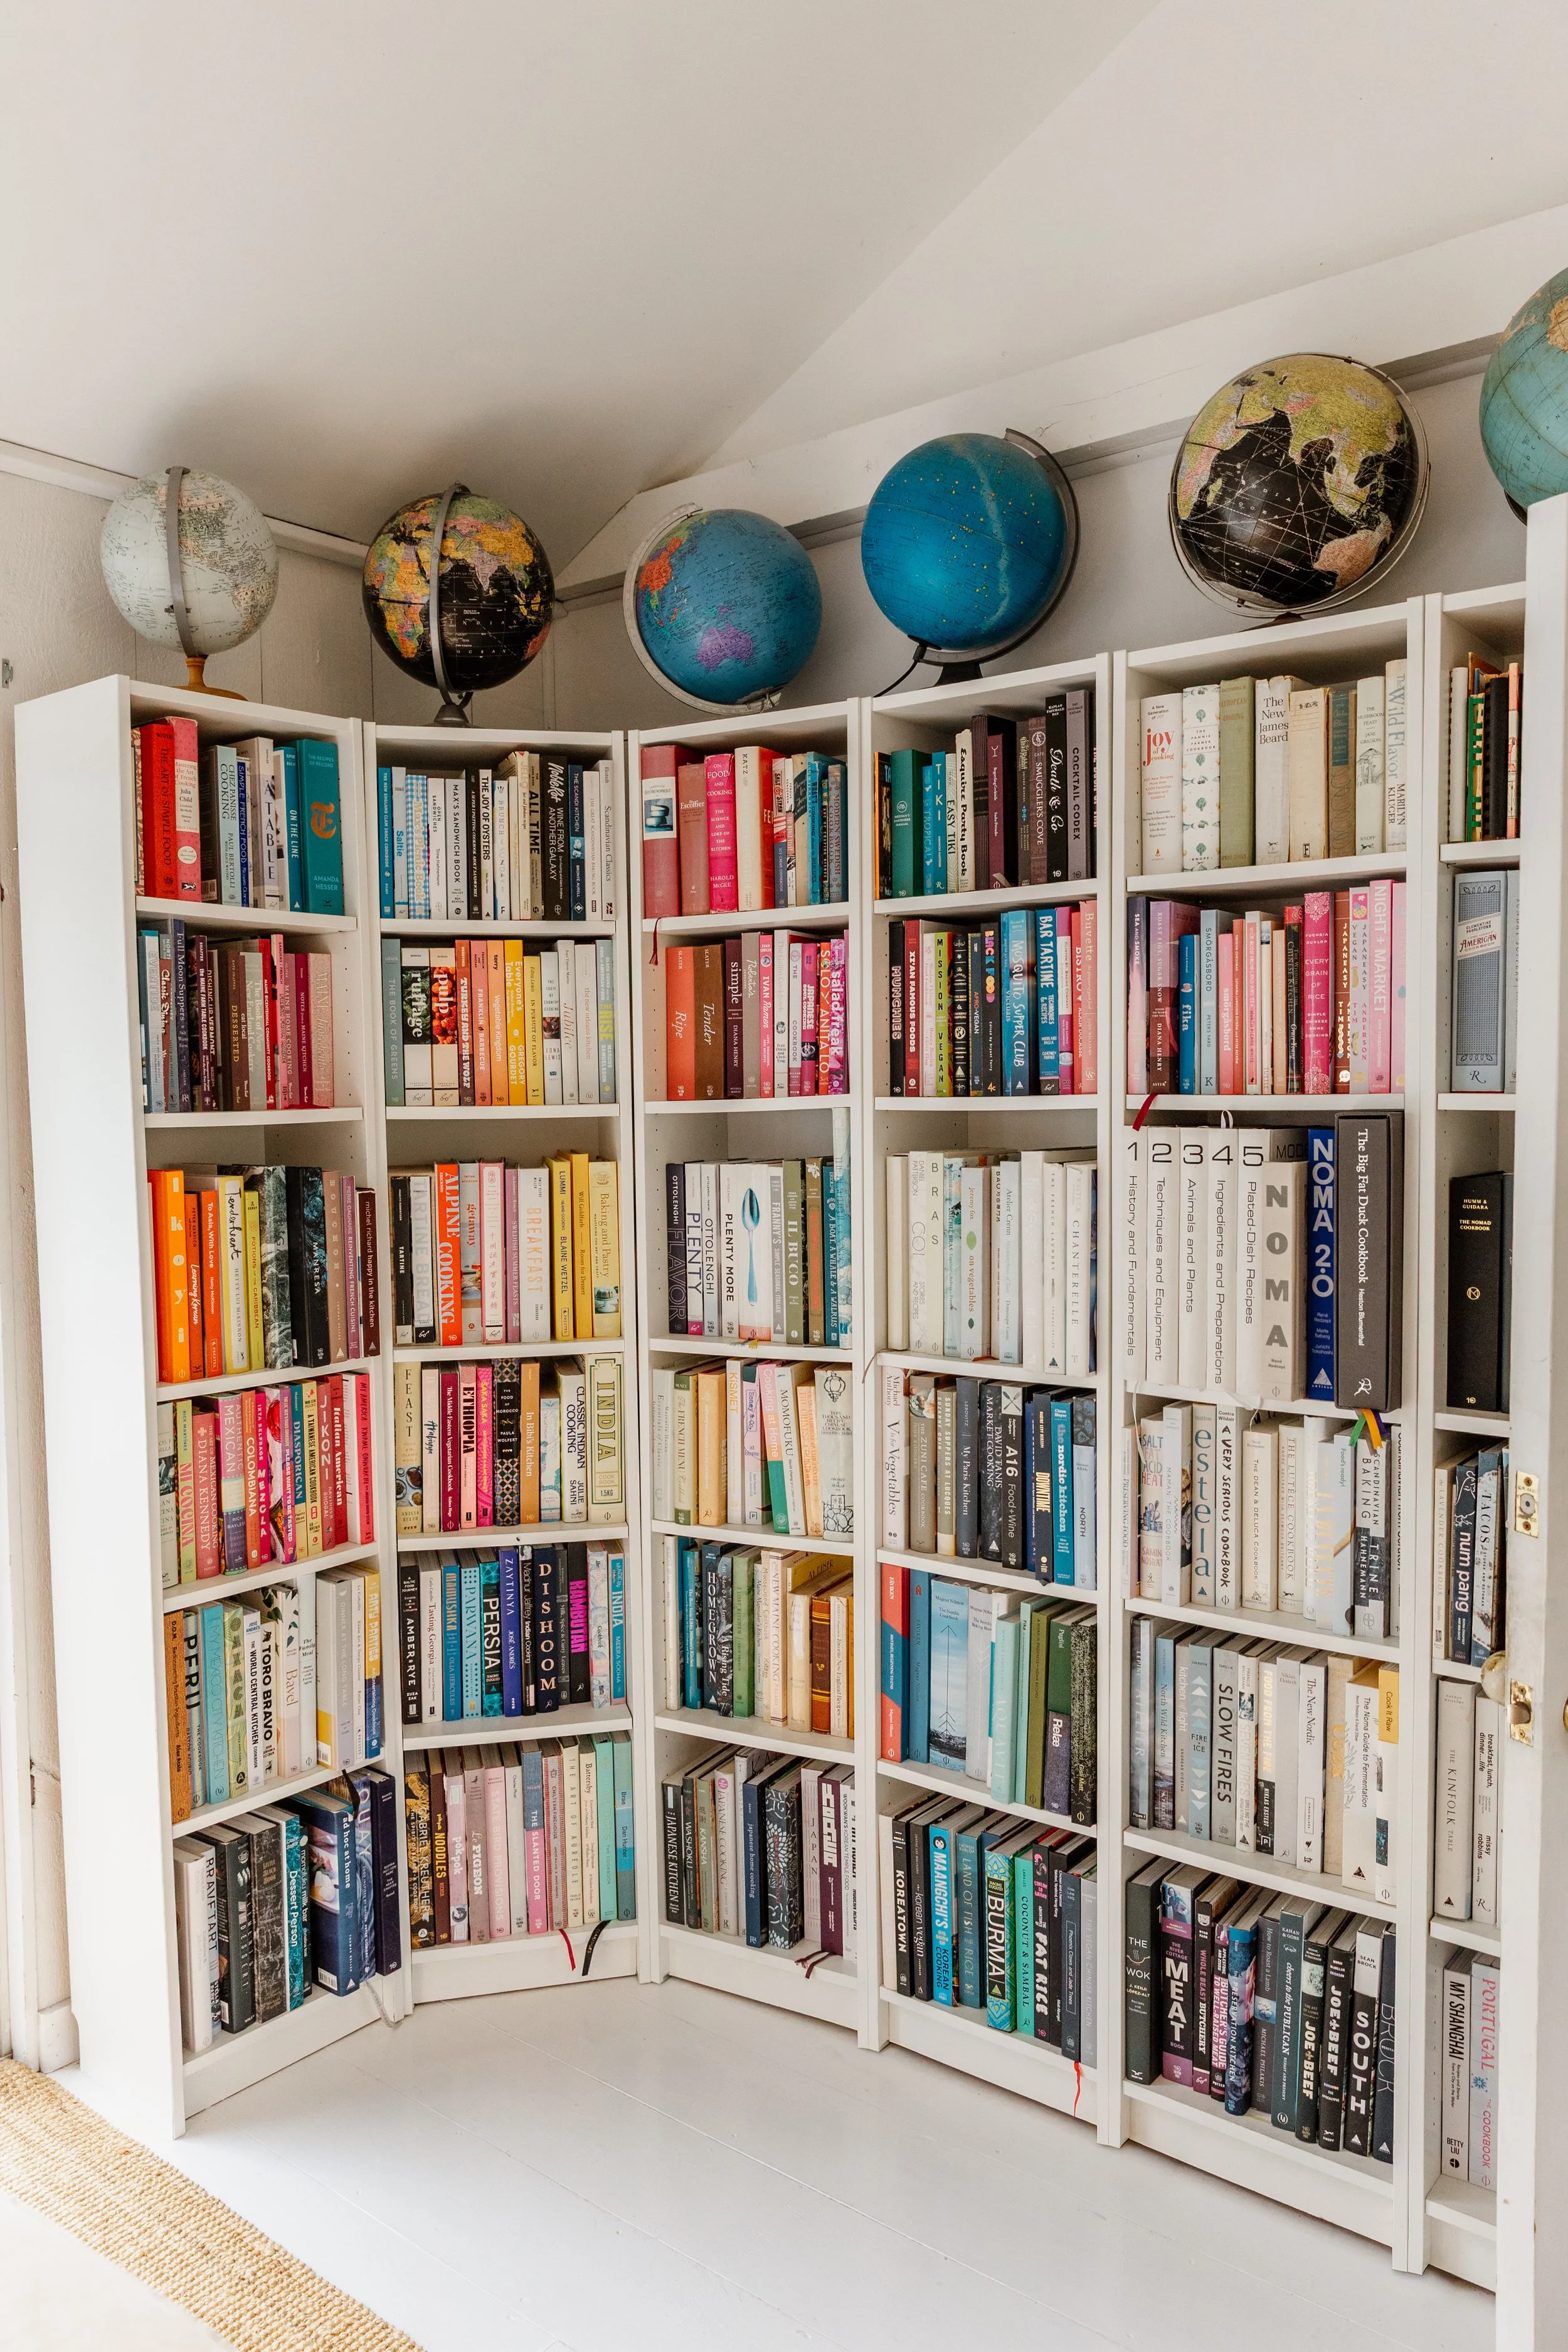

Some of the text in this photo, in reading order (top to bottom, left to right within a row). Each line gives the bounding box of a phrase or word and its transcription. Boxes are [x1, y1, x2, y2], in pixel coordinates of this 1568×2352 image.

[1261, 709, 1285, 719] New
[1264, 697, 1283, 706] The
[1143, 728, 1175, 766] joy
[1259, 721, 1289, 734] James
[1259, 733, 1288, 744] Beard
[220, 763, 230, 819] COOKING
[229, 787, 237, 821] PANISSE
[482, 812, 490, 824] OF
[482, 826, 490, 861] OYSTERS
[1039, 915, 1054, 988] BAR TARTINE
[1459, 933, 1497, 953] AMERICAN
[407, 973, 423, 1038] ruffage
[434, 973, 455, 1014] pulp
[728, 961, 739, 1004] simple
[891, 966, 902, 1040] MUNCHIES
[231, 1005, 240, 1063] DESSERTED
[672, 1010, 687, 1039] Ripe
[703, 1004, 715, 1046] Tender
[1181, 1004, 1191, 1031] fika
[509, 1045, 517, 1085] GOURDET
[517, 1045, 526, 1085] GREGORY
[1128, 1142, 1138, 1161] 1
[1152, 1143, 1172, 1163] 2
[1184, 1145, 1203, 1165] 3
[1212, 1145, 1233, 1165] 4
[1242, 1147, 1264, 1167] 5
[1356, 1154, 1368, 1173] Big
[1358, 1128, 1368, 1151] The
[208, 1202, 214, 1211] To
[444, 1172, 460, 1238] ALPINE
[1312, 1138, 1333, 1232] NOMA
[1358, 1175, 1368, 1192] Fat
[1358, 1195, 1368, 1226] Duck
[686, 1212, 702, 1295] PLENTY
[705, 1218, 714, 1295] OTTOLENGHI
[725, 1213, 733, 1261] PLENTY
[788, 1220, 798, 1286] IL BUCO
[1358, 1228, 1368, 1284] Cookbook
[312, 1241, 320, 1295] MANRESA
[439, 1241, 455, 1324] COOKING
[560, 1236, 569, 1294] BLAINE WETZEL
[1128, 1175, 1138, 1356] History and Fundamentals
[1155, 1177, 1165, 1361] Techniques and Equipment
[1266, 1185, 1288, 1348] NOMA
[566, 1404, 576, 1453] COOKING
[597, 1382, 616, 1461] INDIA
[763, 1369, 778, 1458] Cooking at Home
[780, 1389, 793, 1456] MOMOFUKU
[293, 1421, 303, 1500] DIASPORICAN
[963, 1445, 970, 1461] My
[1195, 1429, 1211, 1577] estela
[1220, 1426, 1232, 1587] A VERY SERIOUS COOKBOOK
[1455, 1532, 1471, 1613] num pang
[484, 1597, 501, 1670] PERSIA
[539, 1564, 556, 1690] DISHOOM
[569, 1580, 588, 1653] RAMBUTAN
[707, 1572, 716, 1683] HOMEGROWN
[262, 1645, 273, 1741] TORO BRAVO
[1052, 1718, 1063, 1748] Relæ
[1191, 1733, 1208, 1742] FIRE
[1193, 1744, 1205, 1753] ICE
[1217, 1683, 1233, 1804] SLOW FIRES
[1446, 1768, 1456, 1825] KINFOLK
[342, 1817, 348, 1829] ad
[435, 1831, 447, 1879] NOODLES
[289, 1870, 298, 1912] Dessert
[896, 1870, 906, 1953] KOREATOWN
[987, 1895, 1005, 1976] BURMA
[1128, 1937, 1148, 1949] THE
[1126, 1967, 1150, 1979] WOK
[1357, 1960, 1377, 1969] BROCK
[1165, 1961, 1189, 2042] MEAT
[1449, 1981, 1465, 2060] MY SHANGHAI
[1350, 2011, 1370, 2114] SOUTH
[1447, 2137, 1464, 2148] BETTY
[1451, 2146, 1459, 2154] LIU
